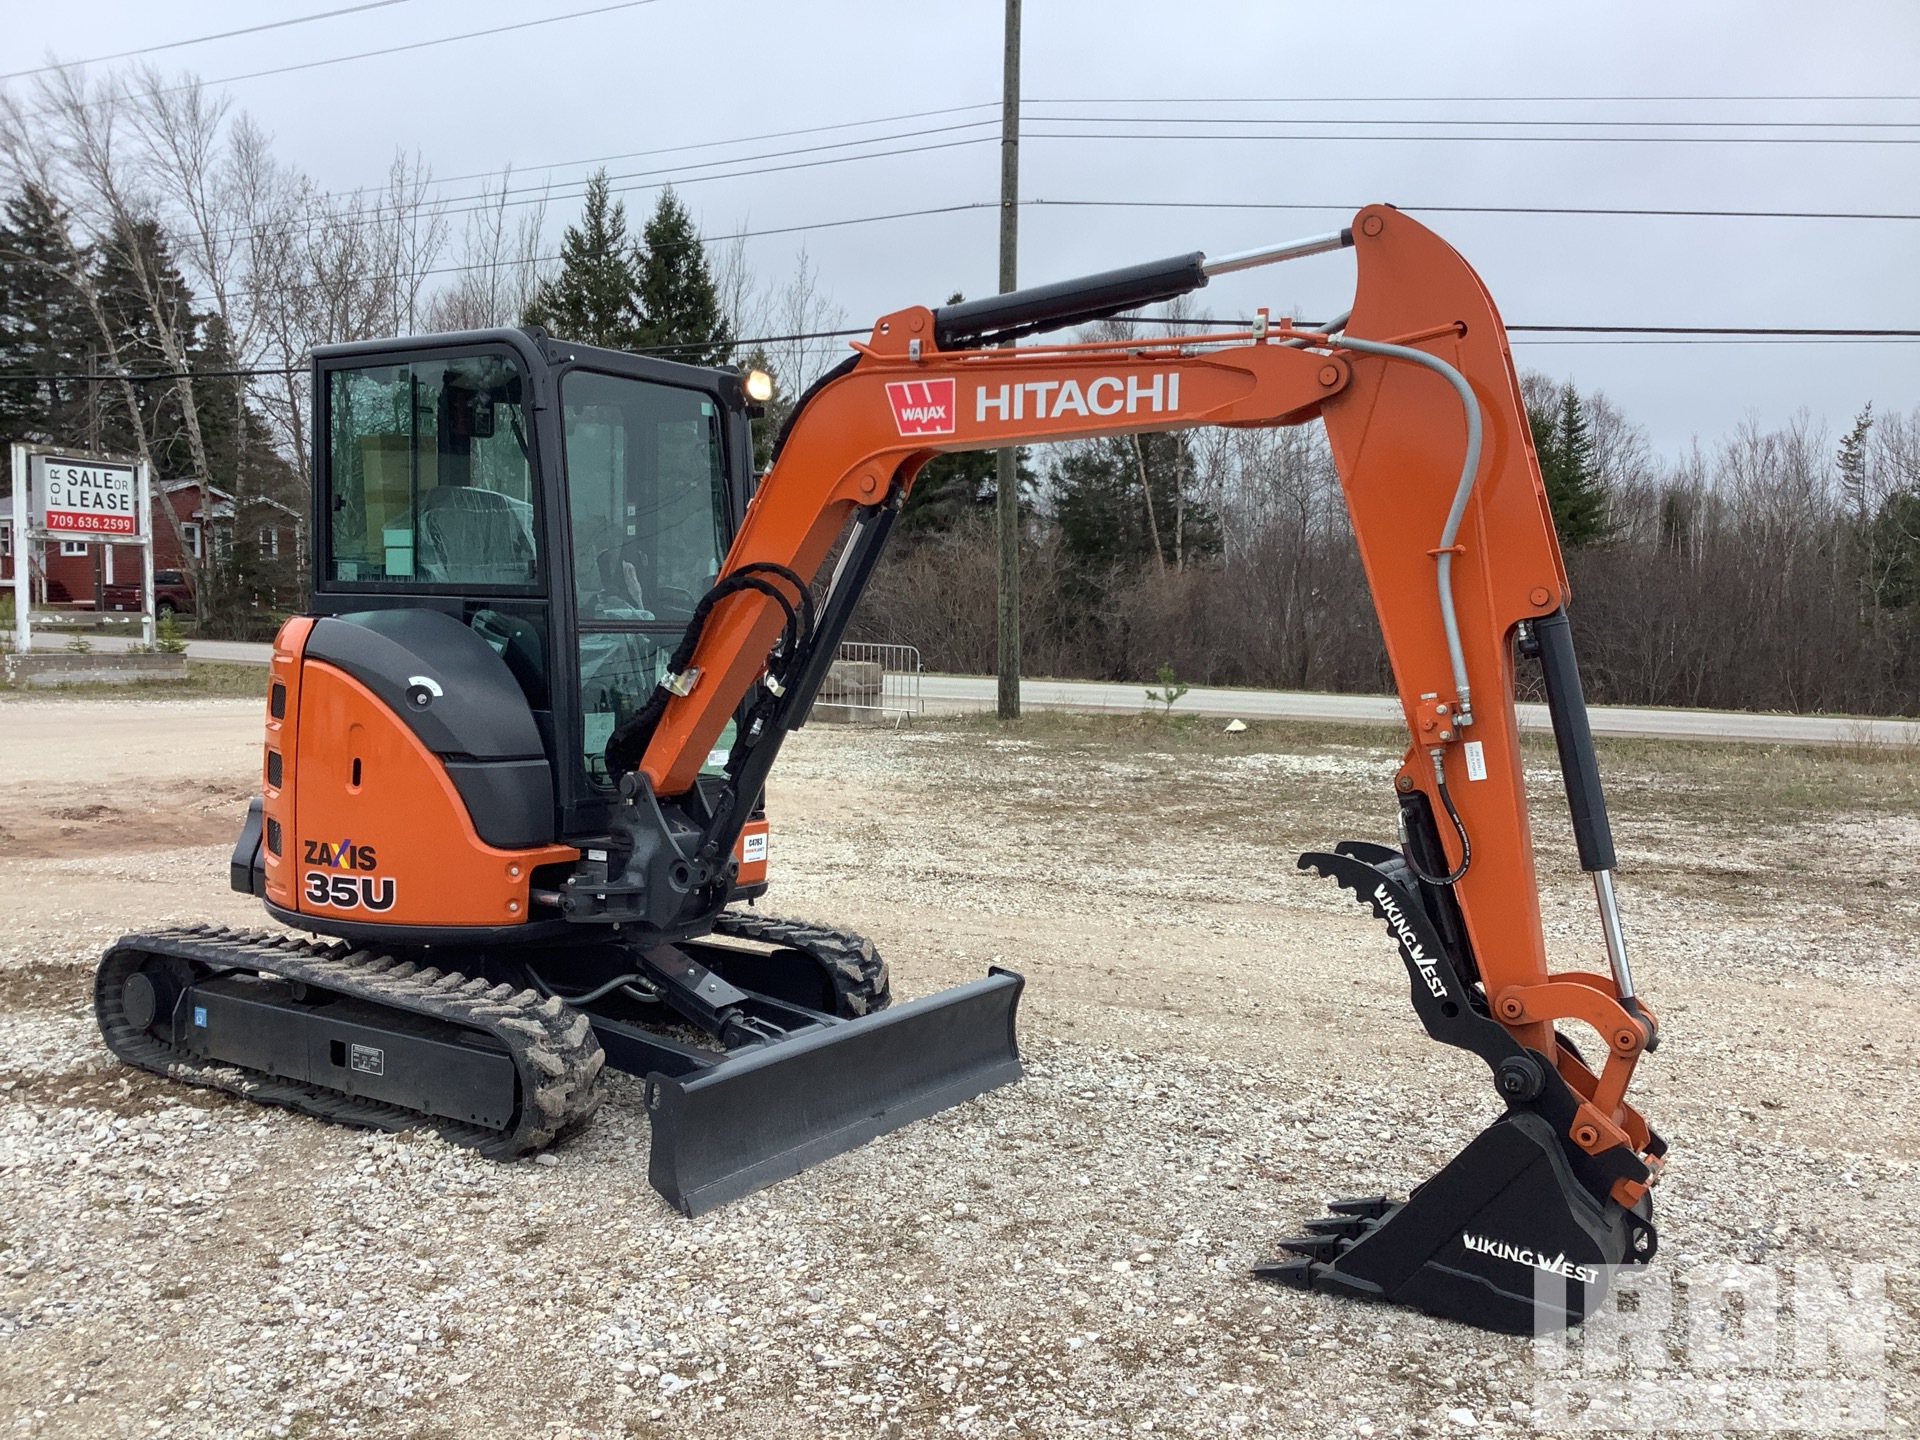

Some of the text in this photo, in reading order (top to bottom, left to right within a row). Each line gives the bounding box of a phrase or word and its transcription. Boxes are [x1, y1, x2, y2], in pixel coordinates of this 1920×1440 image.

[900, 405, 947, 424] WAJAX
[975, 373, 1180, 422] HITACHI
[50, 468, 61, 506] FOR
[66, 468, 128, 491] SALE OR
[67, 489, 129, 511] LEASE
[51, 514, 131, 531] 709.636.2599
[304, 839, 377, 871] ZAXIS
[305, 871, 396, 913] 35U
[1374, 883, 1448, 998] VIKING WEST
[1463, 1233, 1599, 1285] VIKING WEST
